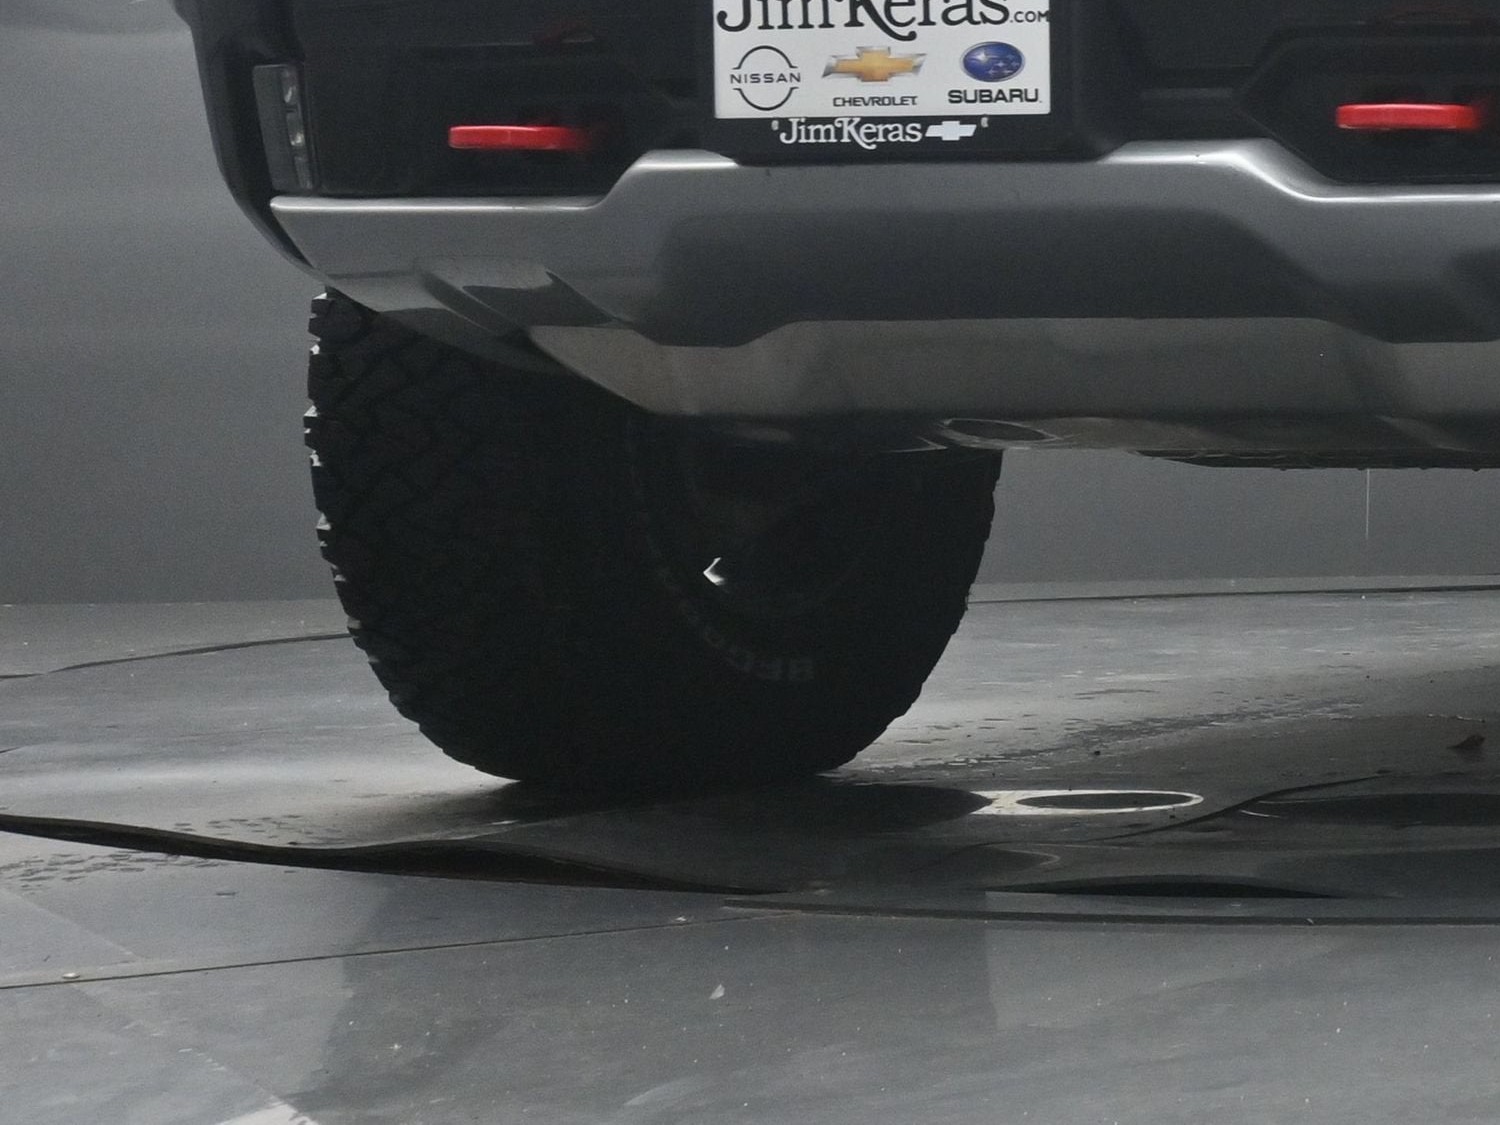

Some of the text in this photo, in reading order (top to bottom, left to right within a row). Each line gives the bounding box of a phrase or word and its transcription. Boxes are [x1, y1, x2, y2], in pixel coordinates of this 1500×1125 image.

[730, 72, 801, 84] NISSAN
[833, 96, 917, 107] CHEVROLET
[948, 88, 1039, 104] SUBARU
